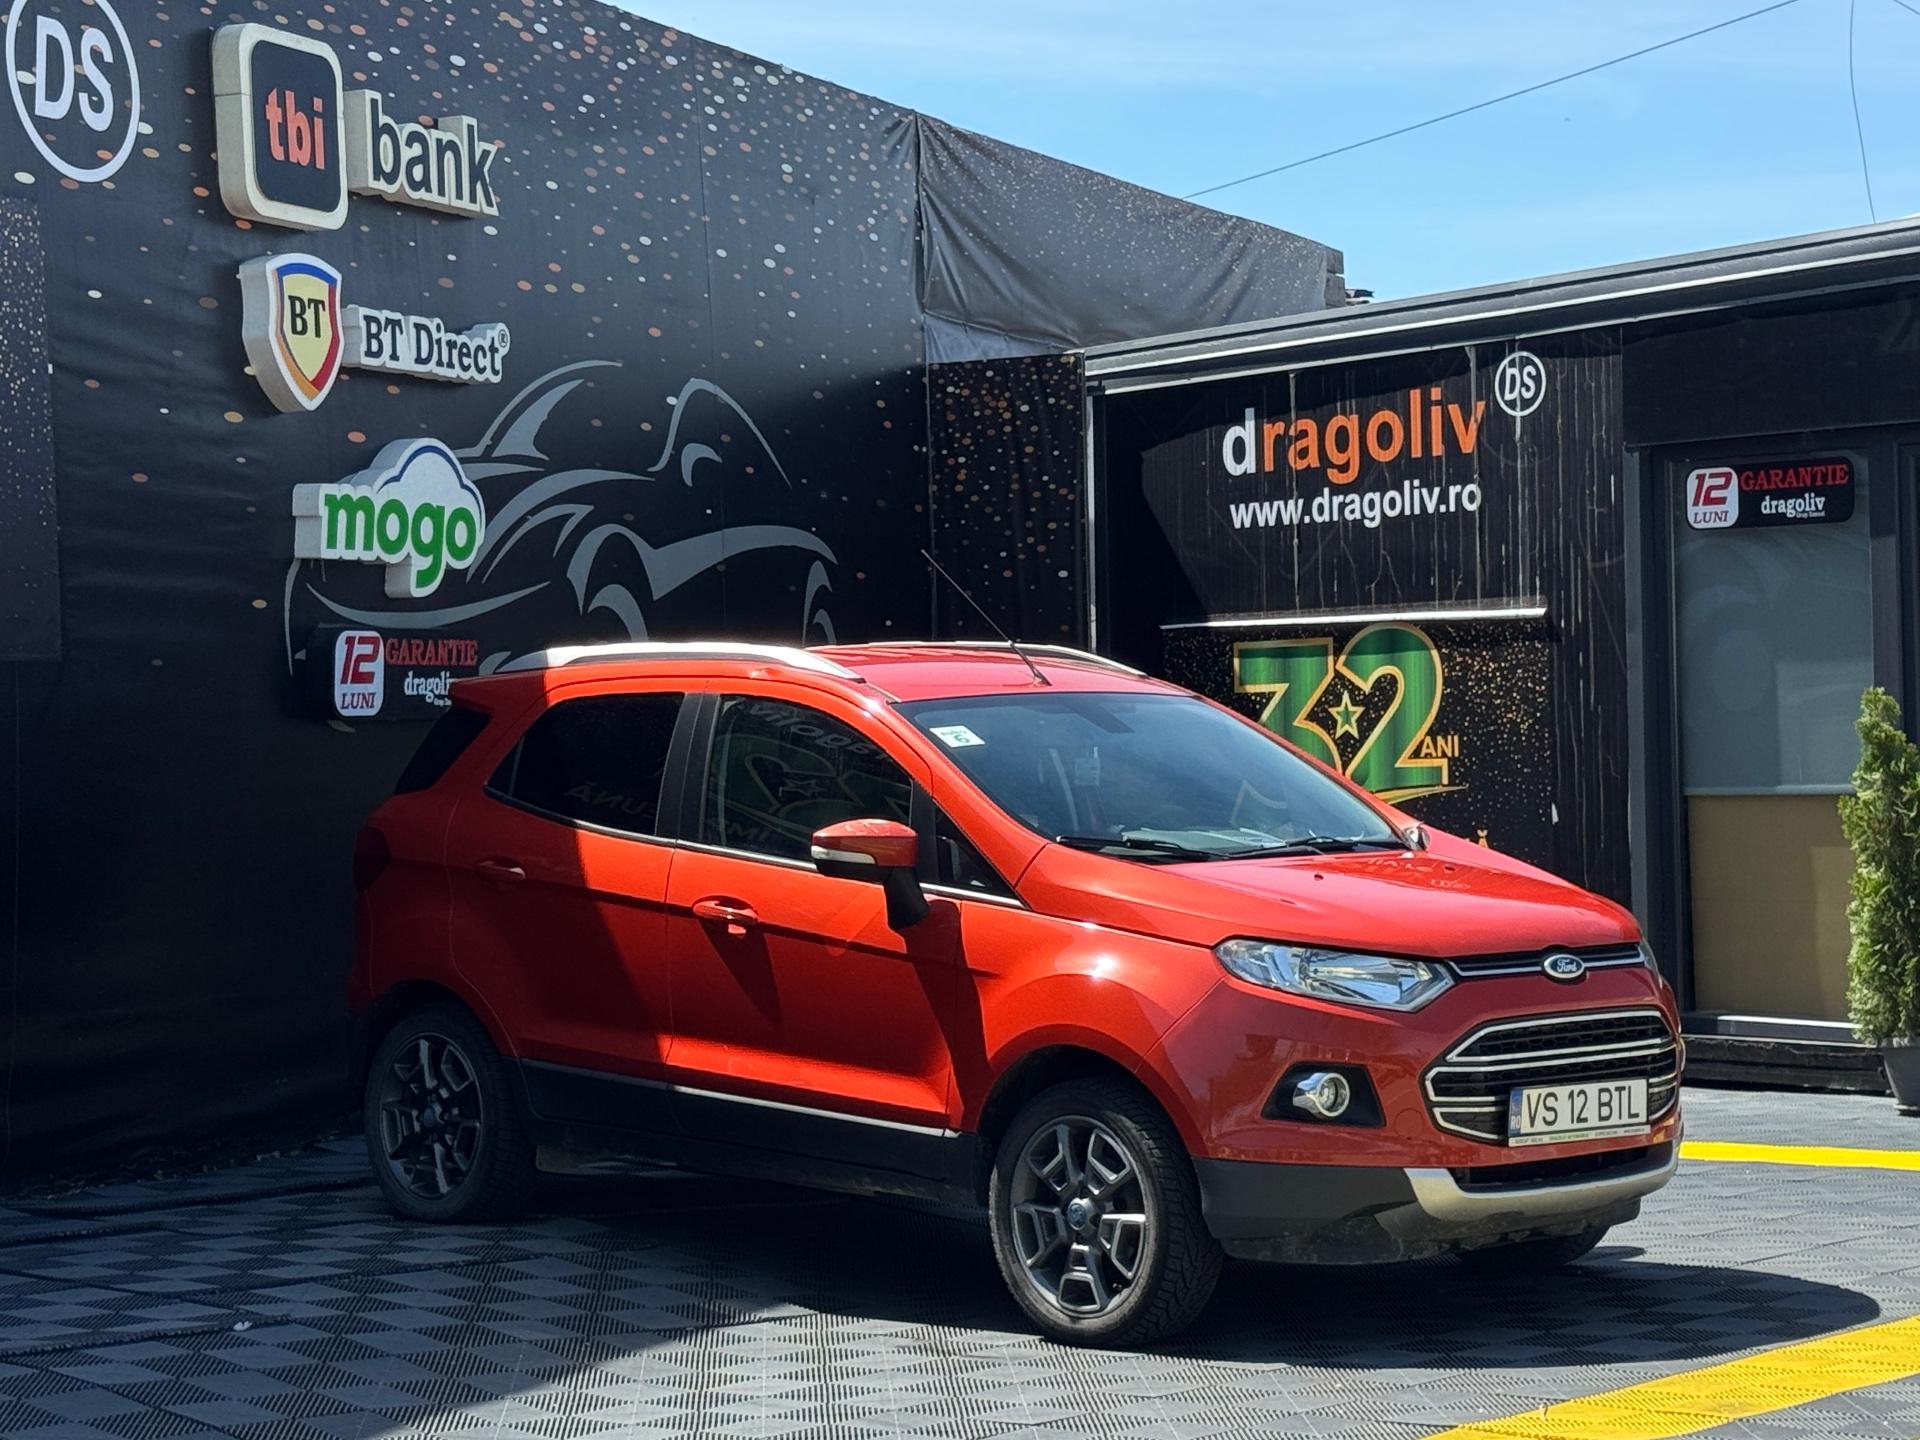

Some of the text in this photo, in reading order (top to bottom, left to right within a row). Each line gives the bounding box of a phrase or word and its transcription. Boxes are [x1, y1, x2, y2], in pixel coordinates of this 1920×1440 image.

[34, 15, 114, 132] DS
[265, 87, 326, 171] tbi
[369, 98, 495, 209] bank
[288, 295, 327, 339] BT
[363, 314, 404, 362] BT
[1503, 363, 1537, 401] DS
[1222, 386, 1486, 485] dragoliv
[1691, 471, 1733, 507] 12
[1740, 463, 1849, 492] GARANTIE
[1229, 478, 1482, 529] www.dragoliv.ro
[1693, 510, 1730, 525] LUNI
[1760, 491, 1826, 518] dragoliv
[324, 493, 477, 589] mogo
[340, 635, 381, 685] 12
[384, 637, 479, 666] GARANTIE
[340, 692, 377, 710] LUNI
[403, 670, 452, 703] dragoli
[1233, 621, 1449, 792] 32
[1420, 735, 1460, 759] ANI
[1556, 958, 1578, 973] Ford
[1511, 1114, 1521, 1130] RO
[1526, 1085, 1640, 1128] VS 12 BTL
